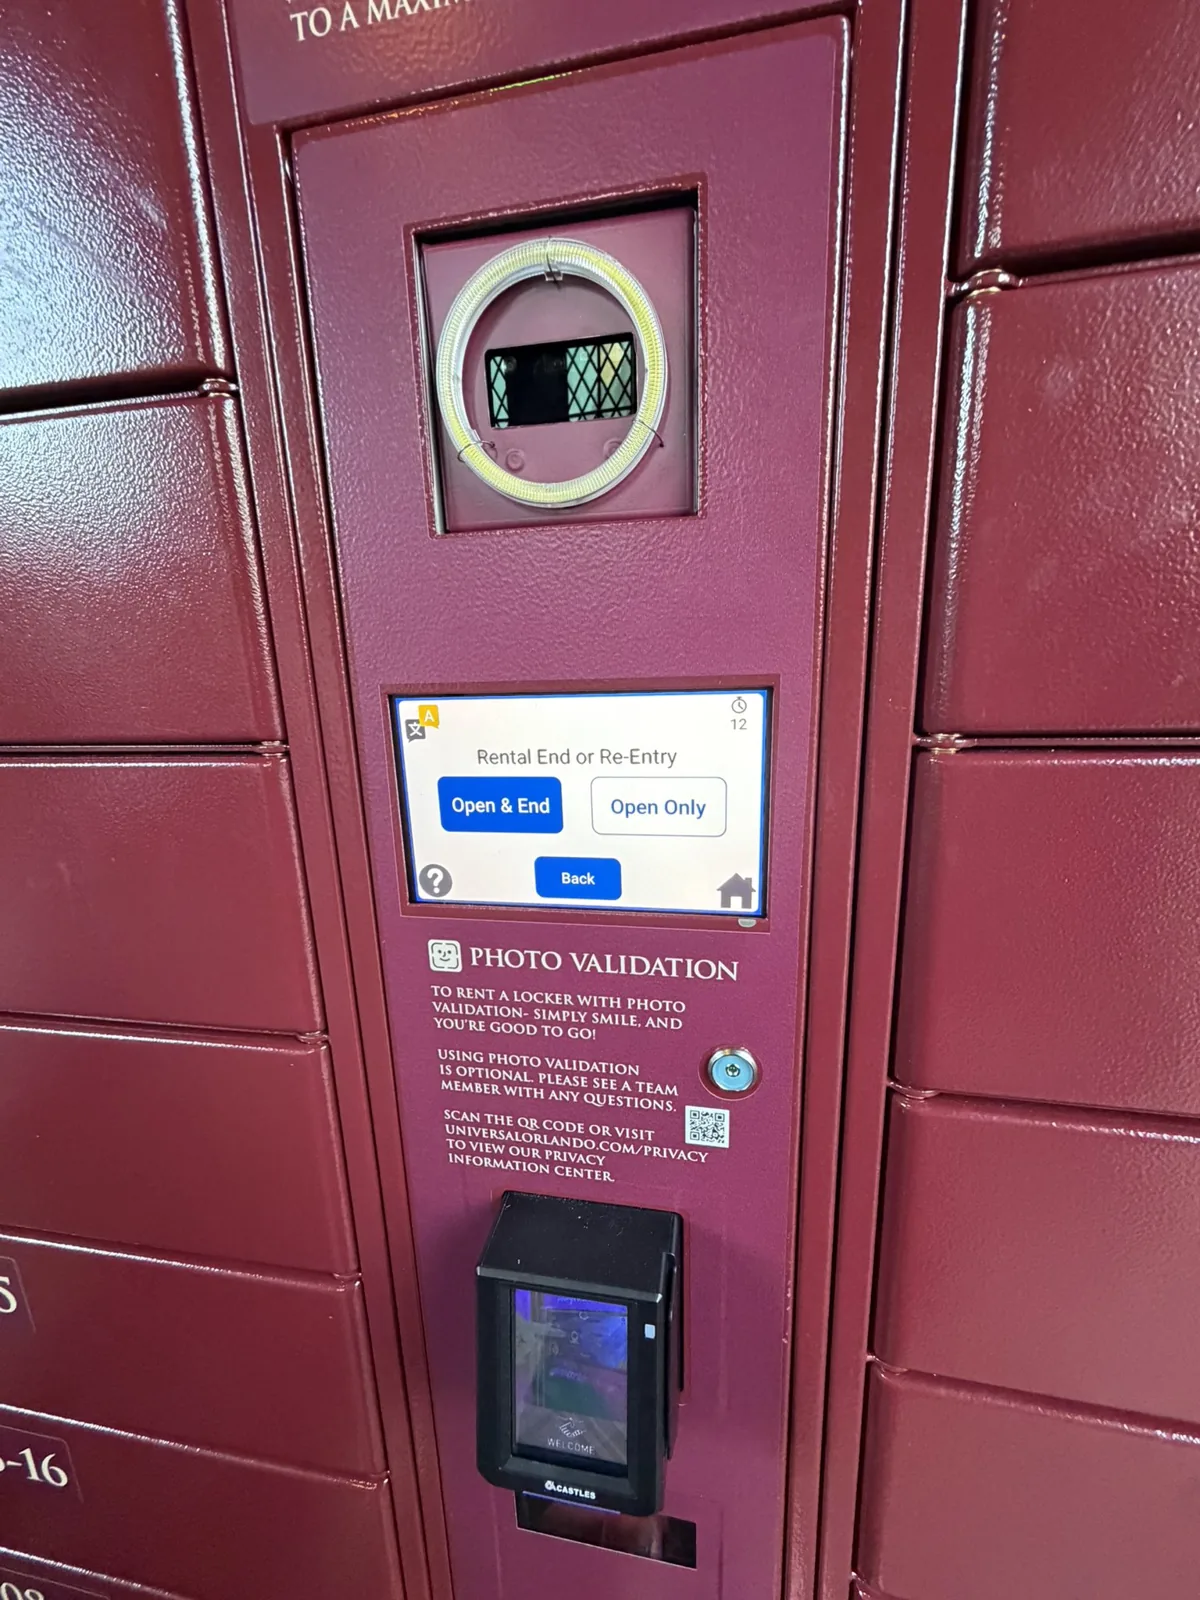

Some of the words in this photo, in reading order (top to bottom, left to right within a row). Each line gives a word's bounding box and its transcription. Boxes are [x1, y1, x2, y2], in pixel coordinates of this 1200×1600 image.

[290, 7, 332, 41] TO
[339, 1, 360, 32] A
[730, 718, 747, 731] 12
[477, 749, 531, 765] Rental
[537, 749, 570, 765] End
[576, 753, 594, 765] or
[600, 749, 677, 769] Re-Entry
[452, 798, 496, 817] Open
[500, 798, 513, 814] &
[518, 797, 550, 814] End
[611, 799, 658, 819] Open
[664, 799, 706, 820] Only
[561, 871, 595, 886] Back
[469, 947, 562, 971] PHOTO
[569, 952, 739, 982] VALIDATION
[430, 985, 452, 998] TO
[456, 987, 495, 1001] RENT
[499, 990, 509, 1001] A
[513, 990, 574, 1006] LOCKER
[577, 994, 621, 1009] WITH
[627, 998, 686, 1013] PHOTO
[433, 1017, 486, 1032] YOU'RE
[489, 1022, 537, 1036] GOOD
[541, 1025, 563, 1038] TO
[567, 1027, 596, 1040] GO!
[533, 1008, 587, 1023] SIMPLY
[591, 1012, 641, 1028] SMILE,
[645, 1017, 683, 1030] AND
[437, 1048, 484, 1063] USING
[488, 1053, 541, 1068] PHOTO
[544, 1057, 640, 1076] VALIDATION
[439, 1064, 452, 1076] IS
[455, 1066, 534, 1083] OPTIONAL.
[538, 1073, 588, 1088] PLEASE
[592, 1078, 617, 1090] SEE
[620, 1080, 632, 1091] A
[635, 1081, 679, 1096] TEAM
[441, 1080, 501, 1095] MEMBER
[503, 1085, 544, 1099] WITH
[548, 1090, 580, 1102] ANY
[583, 1092, 677, 1112] QUESTIONS.
[444, 1109, 480, 1123] SCAN
[484, 1113, 514, 1126] THE
[517, 1117, 540, 1131] QR
[542, 1120, 585, 1134] CODE
[588, 1124, 612, 1137] OR
[614, 1126, 655, 1141] VISIT
[445, 1124, 709, 1163] UNIVERSALORLANDO.COM/PRIVACY
[446, 1138, 466, 1150] TO
[469, 1141, 505, 1154] VIEW
[509, 1146, 541, 1159] OUR
[544, 1150, 606, 1166] PRIVACY
[448, 1153, 549, 1174] INFORMATION
[547, 1438, 595, 1455] WELCOME
[0, 1448, 68, 1487] -16
[556, 1484, 596, 1500] CASTLES
